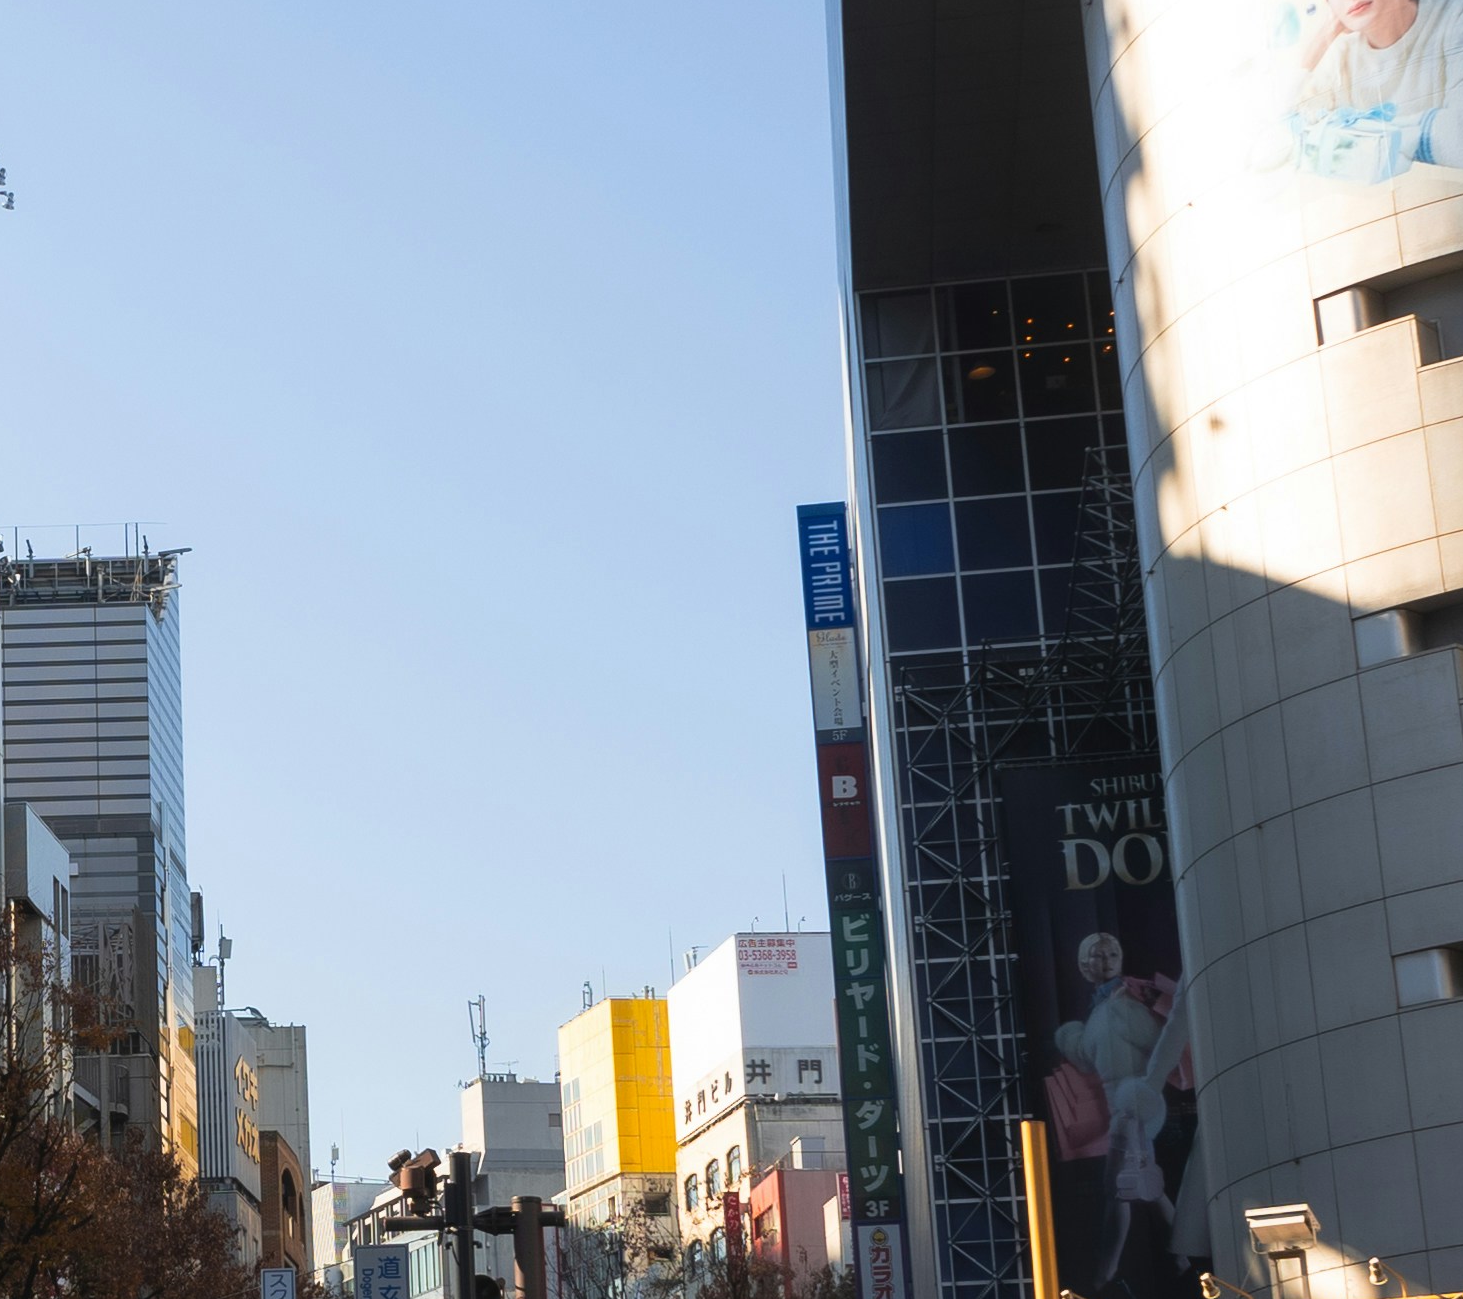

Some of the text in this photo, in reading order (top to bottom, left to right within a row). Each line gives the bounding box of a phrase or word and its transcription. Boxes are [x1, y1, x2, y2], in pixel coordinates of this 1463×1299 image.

[807, 519, 846, 624] THE PRIME
[829, 650, 844, 726] 大型イベント会場
[832, 730, 848, 741] 5F
[1054, 796, 1166, 837] TWIL
[1058, 832, 1174, 892] DO
[834, 892, 872, 903] バグース
[738, 938, 795, 948] 広告主募集中
[738, 949, 797, 962] 03-5368-3958
[839, 913, 890, 1193] ビリヤード・ダーツ
[745, 1058, 824, 1085] 井門
[683, 1070, 733, 1126] 井門ビル
[865, 1202, 891, 1218] 3F
